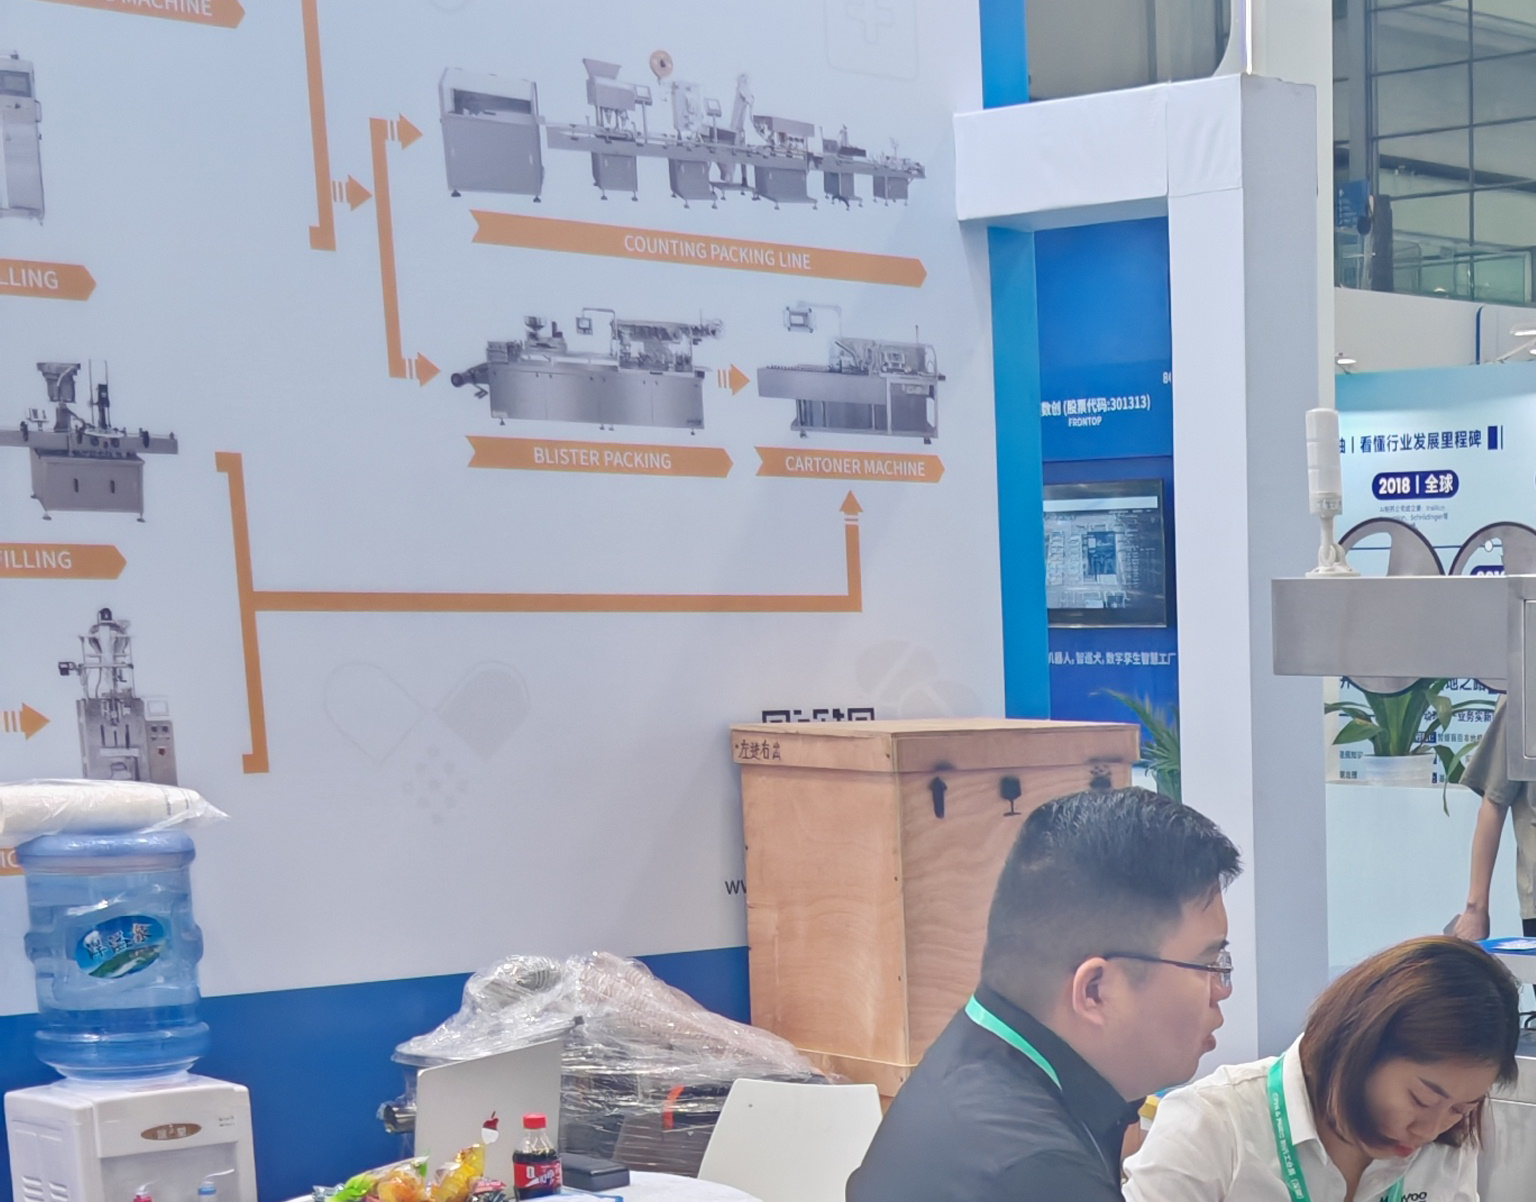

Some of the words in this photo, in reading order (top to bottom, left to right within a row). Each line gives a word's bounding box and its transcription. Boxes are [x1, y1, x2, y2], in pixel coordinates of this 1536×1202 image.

[122, 0, 213, 17] CHINE
[624, 234, 707, 259] COUNTING
[710, 243, 775, 267] PACKING
[779, 251, 812, 270] LINE
[1068, 416, 1102, 427] FRONTOP
[1360, 430, 1482, 454] 看懂行业发展里程碑
[533, 447, 600, 466] BLISTER
[604, 450, 672, 469] PACKING
[785, 456, 861, 474] CARTONER
[864, 459, 926, 477] MACHINE
[1379, 477, 1411, 495] 2018
[1424, 473, 1454, 494] 全球
[0, 550, 72, 569] ILLING
